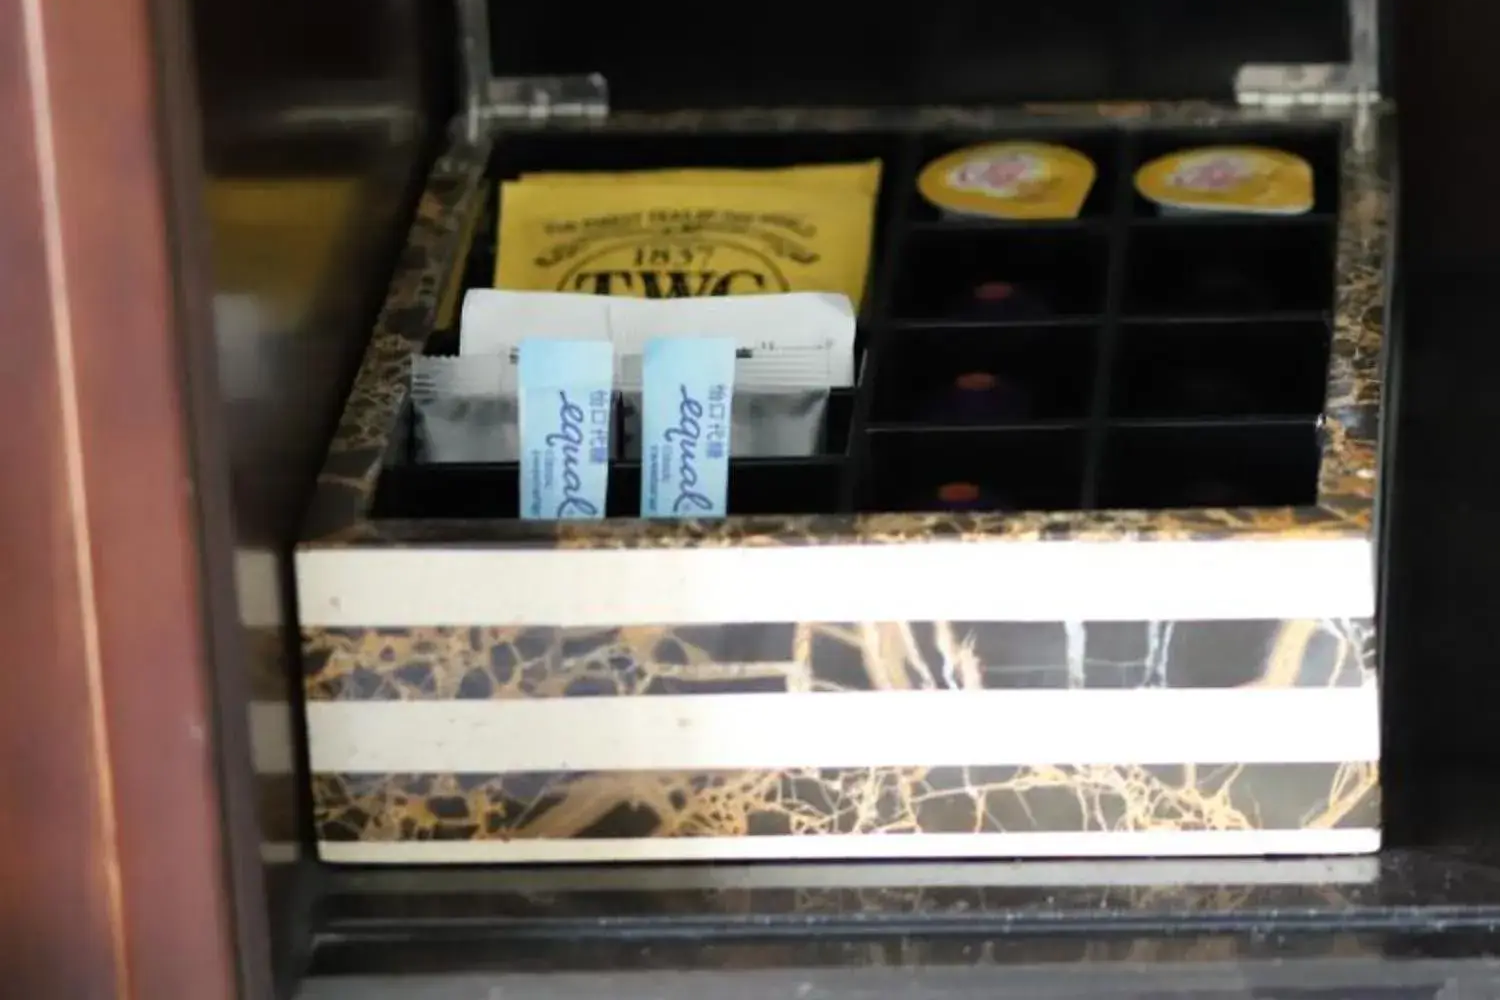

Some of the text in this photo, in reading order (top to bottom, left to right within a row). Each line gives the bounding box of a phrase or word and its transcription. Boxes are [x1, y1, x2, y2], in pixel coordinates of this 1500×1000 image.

[633, 247, 716, 268] 1837
[546, 391, 598, 517] equal
[664, 384, 713, 513] equal
